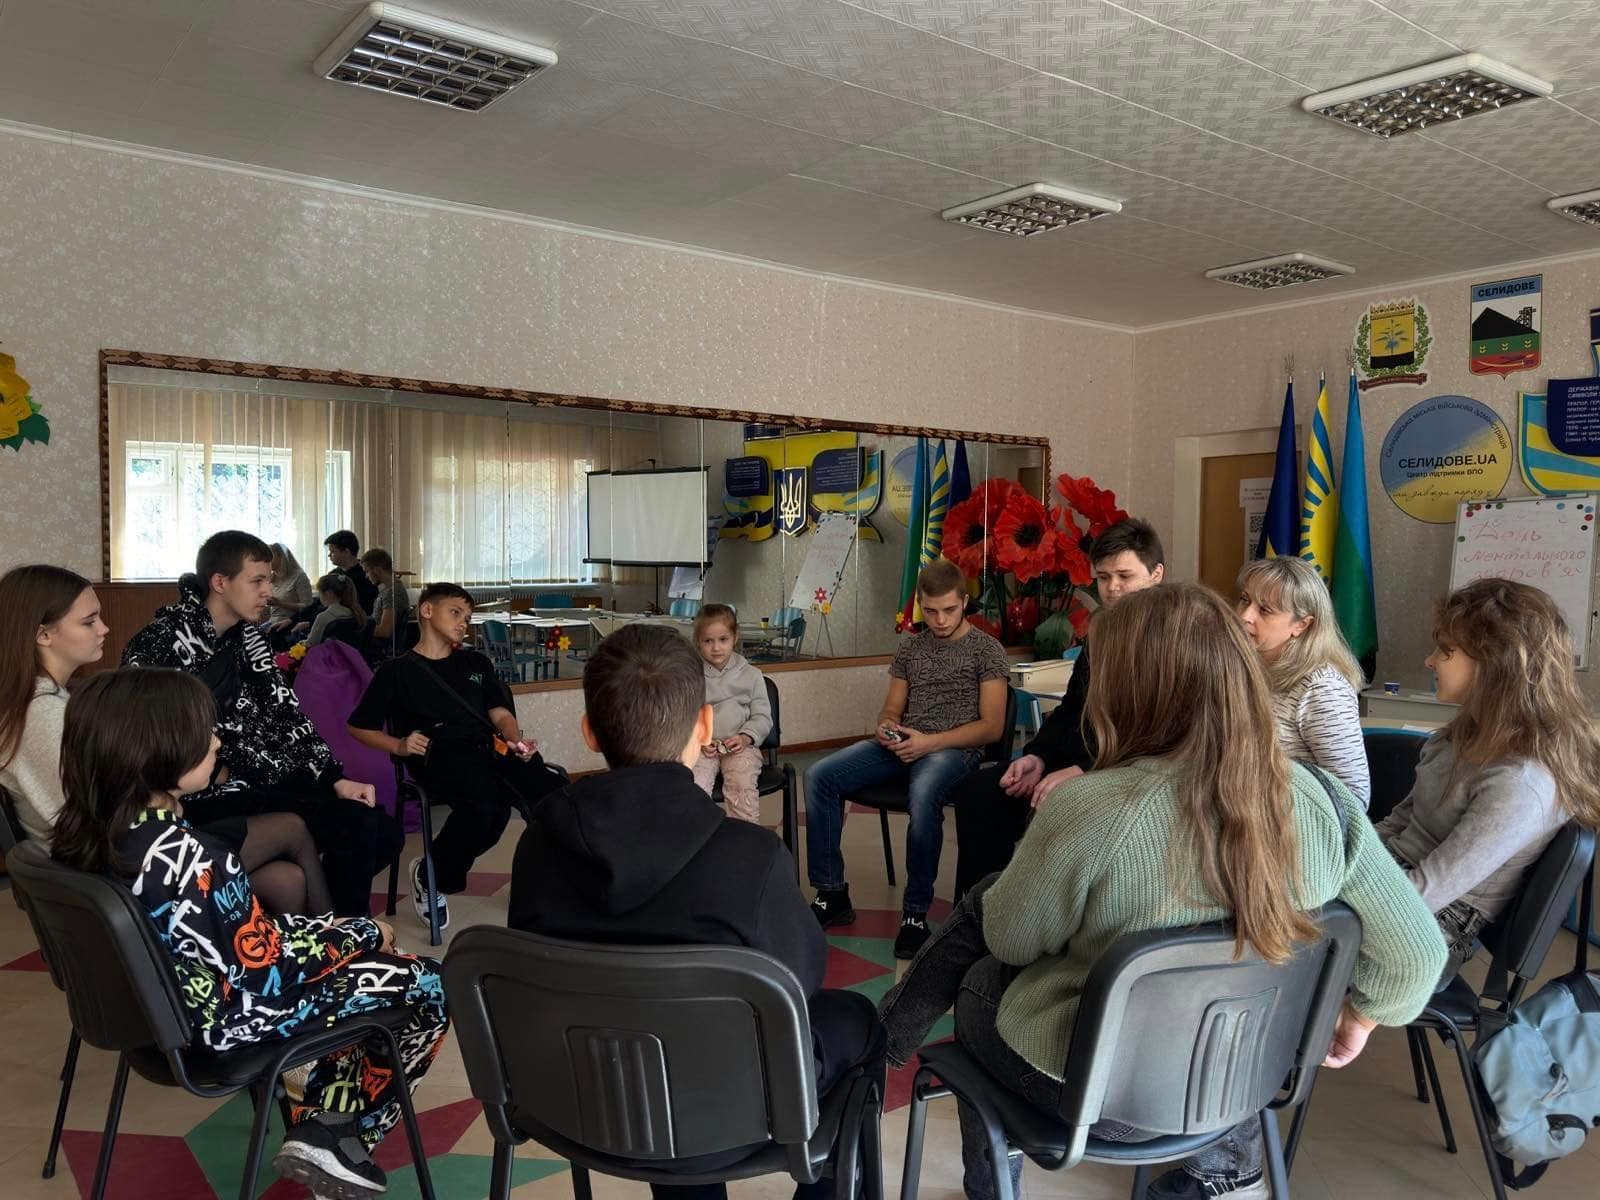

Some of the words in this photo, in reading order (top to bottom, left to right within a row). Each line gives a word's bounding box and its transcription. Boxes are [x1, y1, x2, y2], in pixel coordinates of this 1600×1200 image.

[1478, 281, 1535, 297] СЕЛИДОВЕ
[1398, 453, 1498, 470] СЕЛИДОВЕ.UA
[1407, 470, 1428, 479] Центр
[1429, 470, 1466, 479] підтримки
[1466, 468, 1485, 476] ВПО
